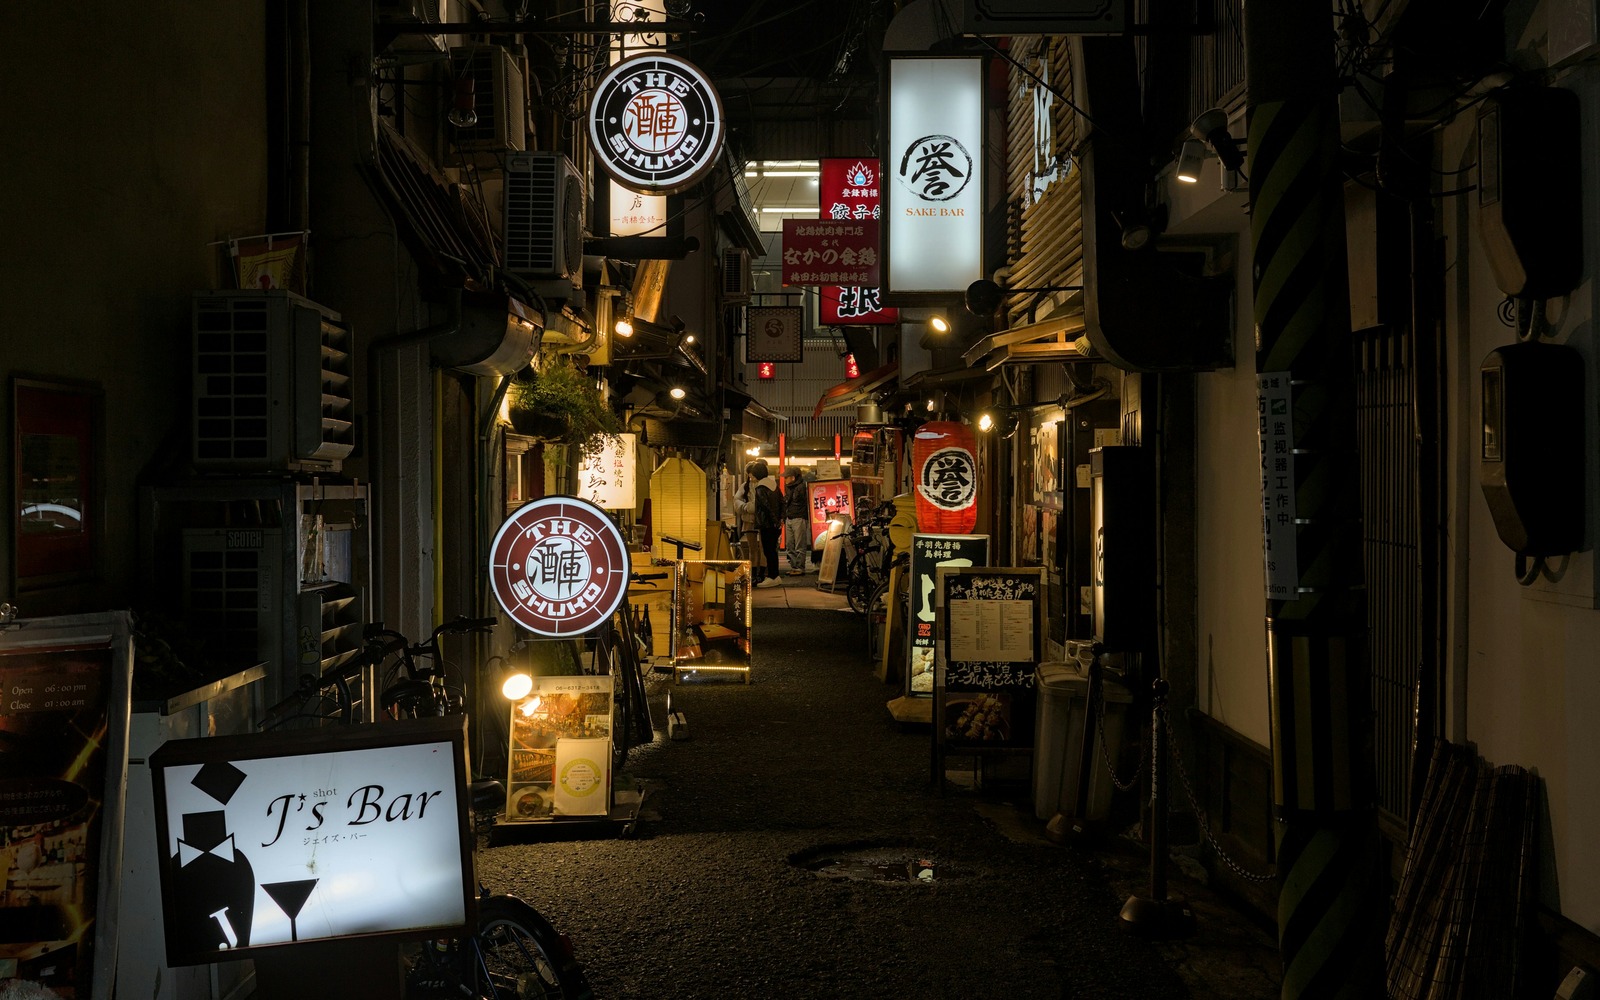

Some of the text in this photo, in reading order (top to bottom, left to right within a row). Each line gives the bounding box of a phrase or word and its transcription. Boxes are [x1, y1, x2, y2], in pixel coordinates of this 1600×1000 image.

[621, 73, 690, 98] THE
[609, 132, 699, 170] SHUKO
[911, 142, 965, 196] 誉
[841, 187, 879, 198] 登録商標
[905, 207, 965, 217] SAKE BAR
[795, 226, 865, 237] 地鶏焼肉専門店
[783, 247, 877, 266] なかの食鶏
[933, 458, 971, 501] 誉
[228, 530, 262, 548] SCOTCH
[525, 520, 594, 546] THE
[916, 540, 962, 550] 手羽先唐揚
[512, 579, 602, 617] SHUKO
[11, 686, 34, 697] Open
[73, 684, 87, 693] pm
[10, 700, 31, 710] Close
[312, 787, 338, 798] shot
[347, 784, 442, 827] Bar
[302, 831, 368, 846] ジェイズ・バー
